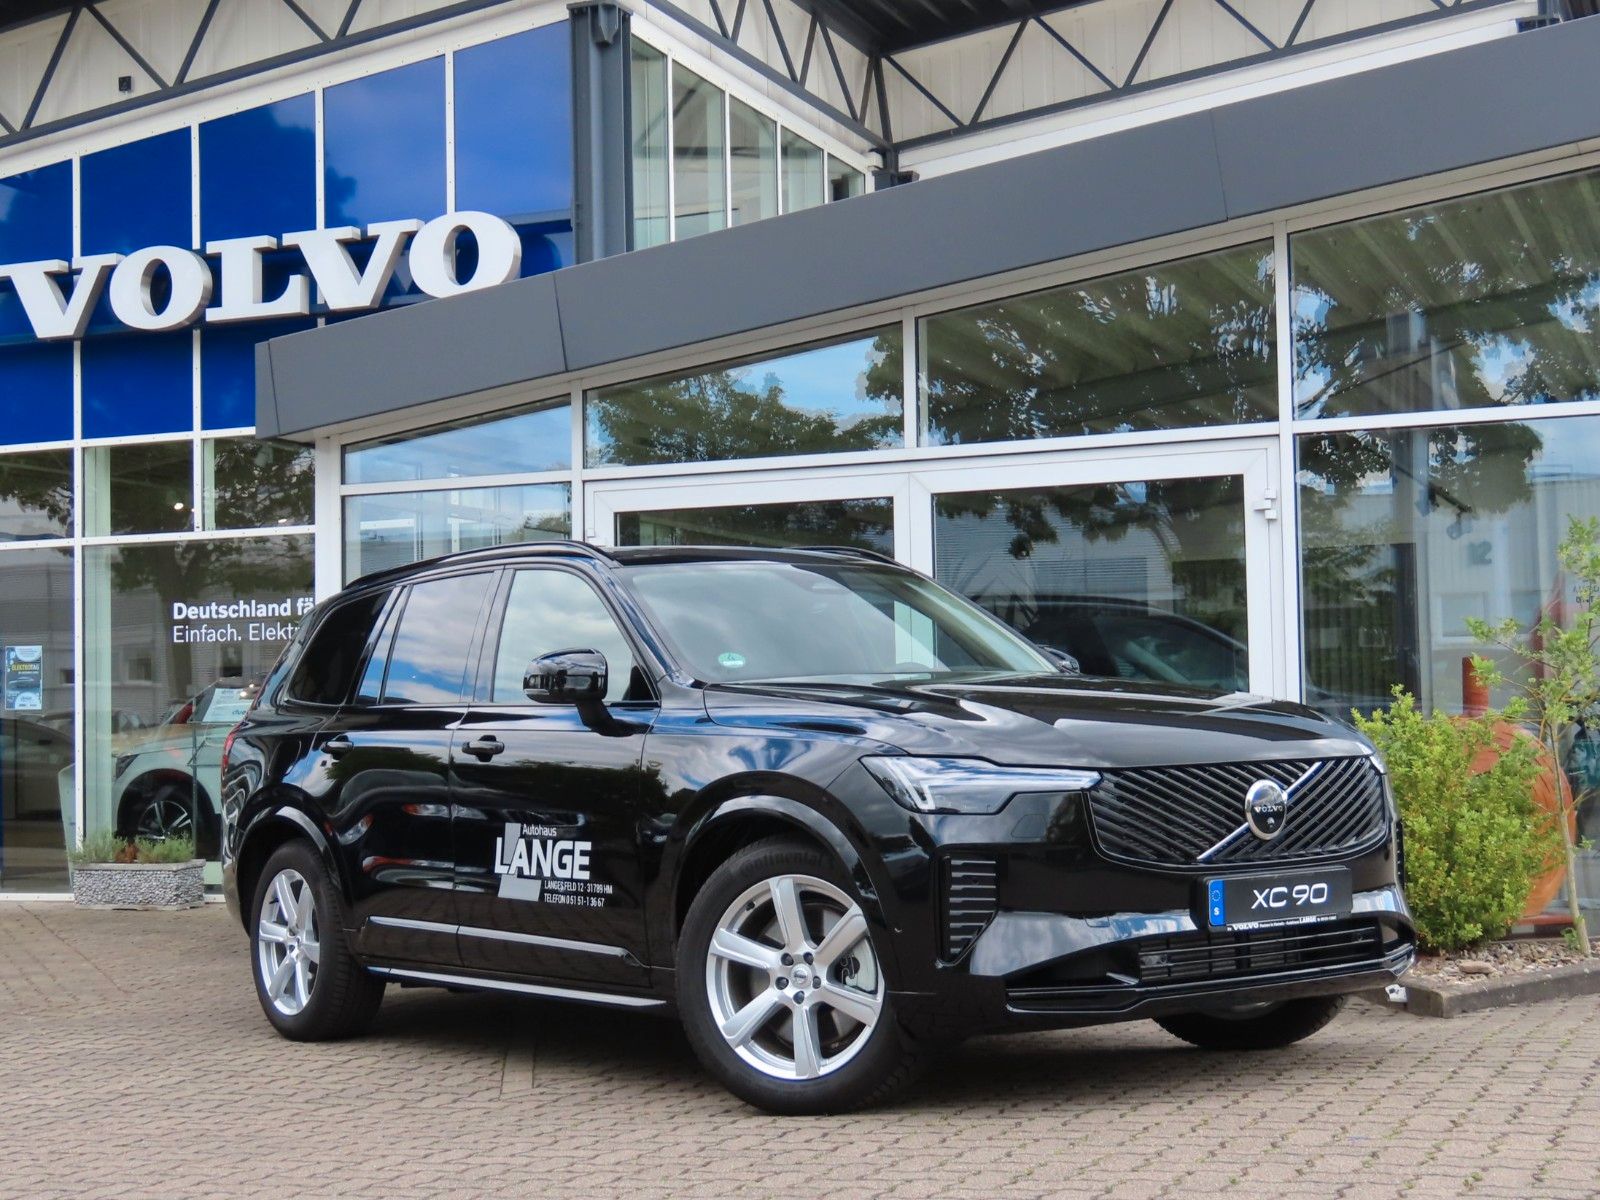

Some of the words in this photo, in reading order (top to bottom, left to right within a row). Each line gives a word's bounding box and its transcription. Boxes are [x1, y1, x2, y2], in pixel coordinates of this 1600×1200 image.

[0, 211, 522, 340] VOLVO
[173, 598, 291, 619] Deutschland
[173, 624, 242, 642] Einfach.
[1254, 805, 1283, 813] VOLVO
[522, 823, 557, 837] Autohaus
[494, 837, 592, 880] LANGE
[1232, 922, 1259, 931] VOLVO
